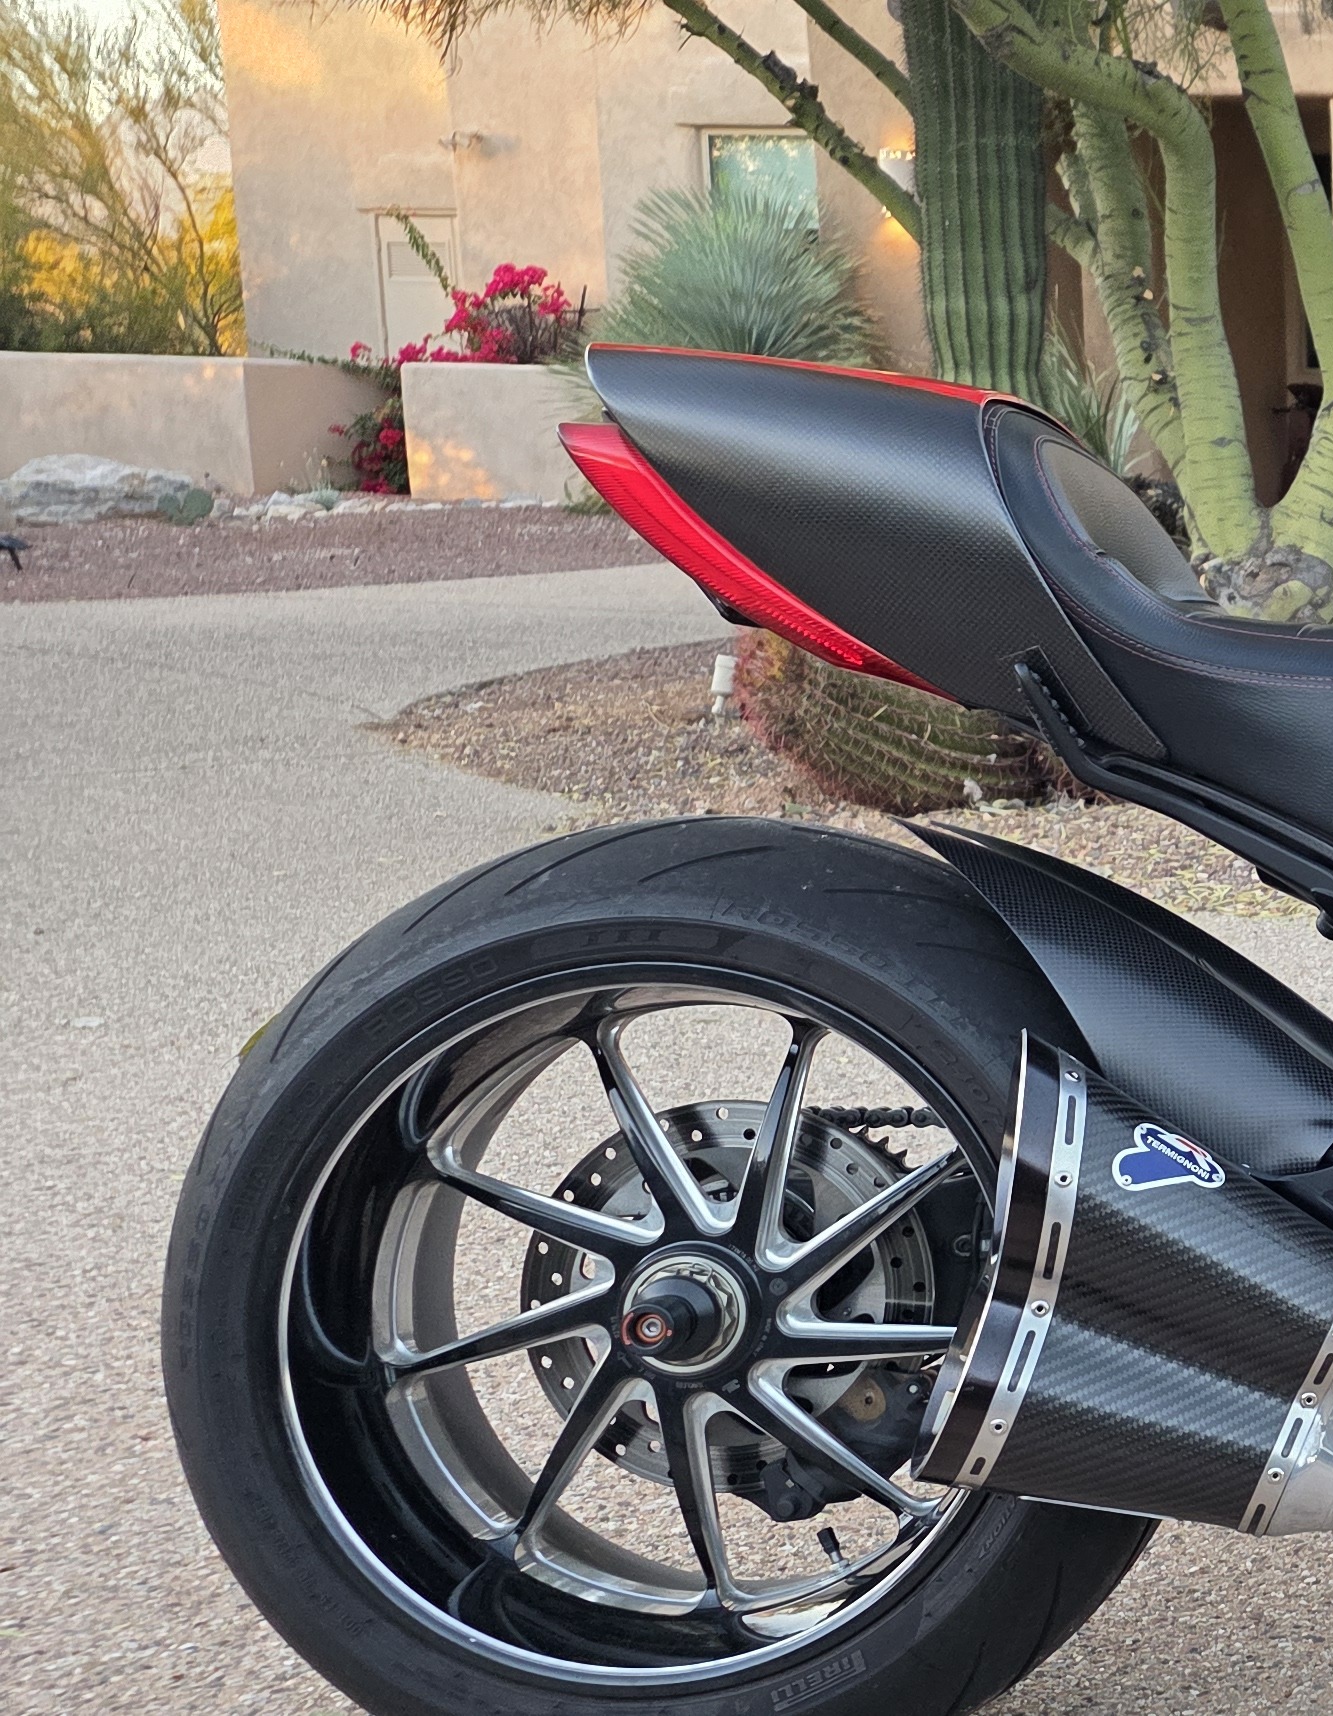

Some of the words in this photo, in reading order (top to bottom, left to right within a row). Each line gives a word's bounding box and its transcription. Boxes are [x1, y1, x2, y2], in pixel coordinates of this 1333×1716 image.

[362, 954, 498, 1041] ROSSO
[1146, 1135, 1210, 1180] TERMIGNONI
[769, 1649, 870, 1711] PIRELLI
